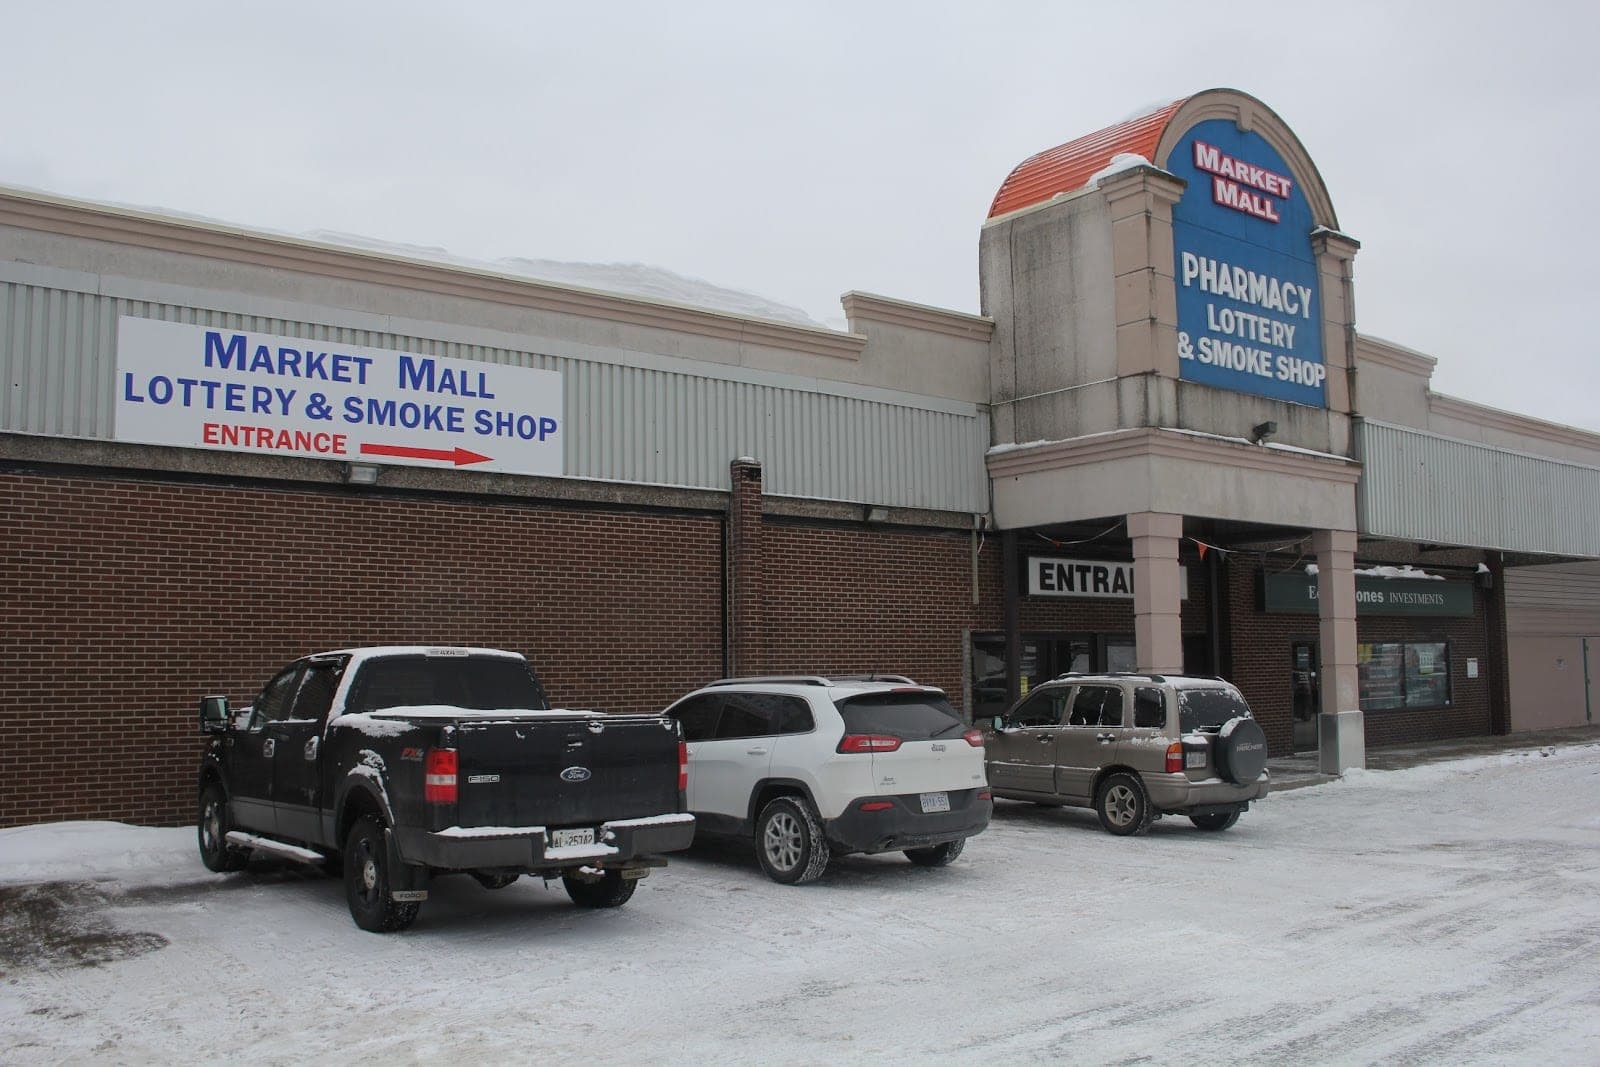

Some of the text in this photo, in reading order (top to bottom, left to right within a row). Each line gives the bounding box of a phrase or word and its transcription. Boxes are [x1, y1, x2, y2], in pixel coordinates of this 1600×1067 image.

[1194, 142, 1291, 198] MARKET
[1214, 179, 1279, 222] MALL
[1181, 251, 1312, 319] PHARMACY
[1206, 303, 1296, 350] LOTTERY
[203, 331, 495, 399] MARKET MALL
[1177, 331, 1326, 388] & SMOKE SHOP
[124, 372, 558, 442] LOTTERY & SMOKE SHOP
[202, 422, 347, 455] ENTRANCE
[1039, 562, 1134, 594] ENTRA
[1355, 590, 1444, 605] ones INVESTMENTS
